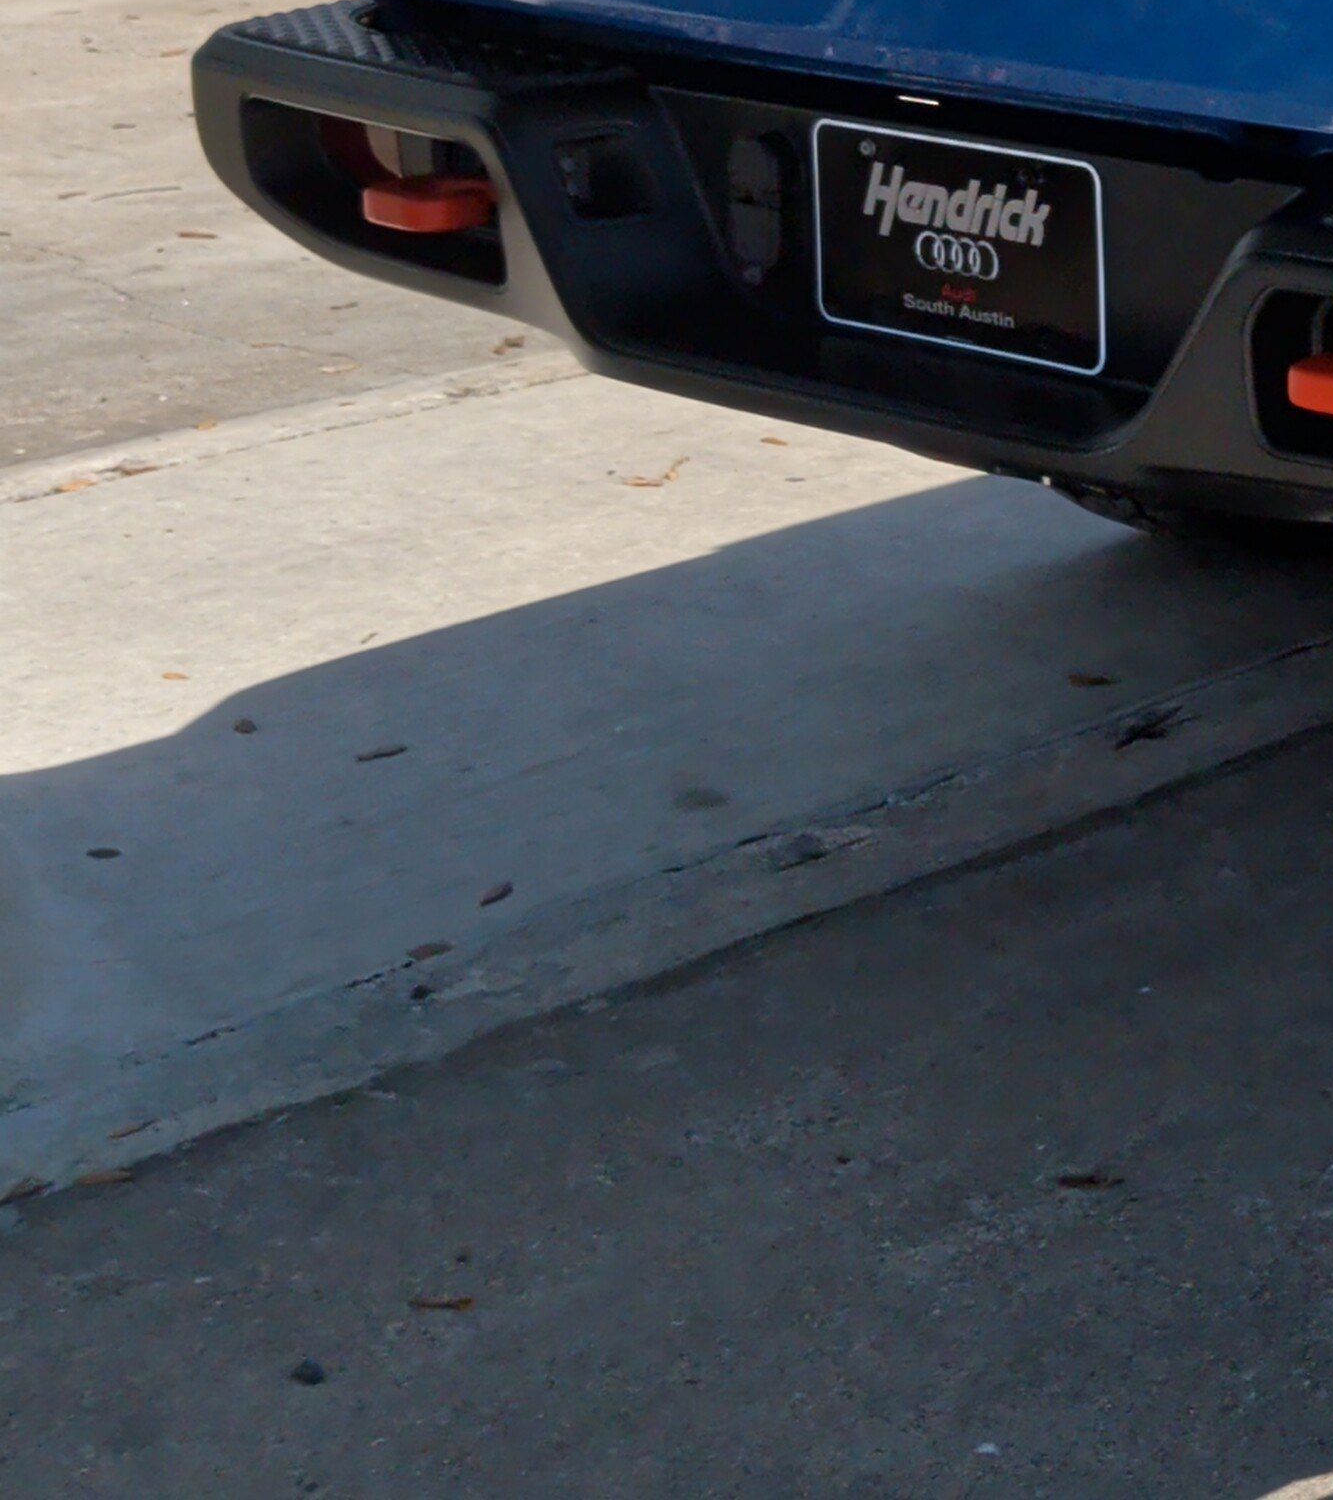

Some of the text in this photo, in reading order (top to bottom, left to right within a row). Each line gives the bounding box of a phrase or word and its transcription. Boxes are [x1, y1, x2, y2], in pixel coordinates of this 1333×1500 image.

[863, 161, 1050, 246] Hendrick
[903, 292, 1015, 329] South Austin
[941, 283, 977, 305] Audi
